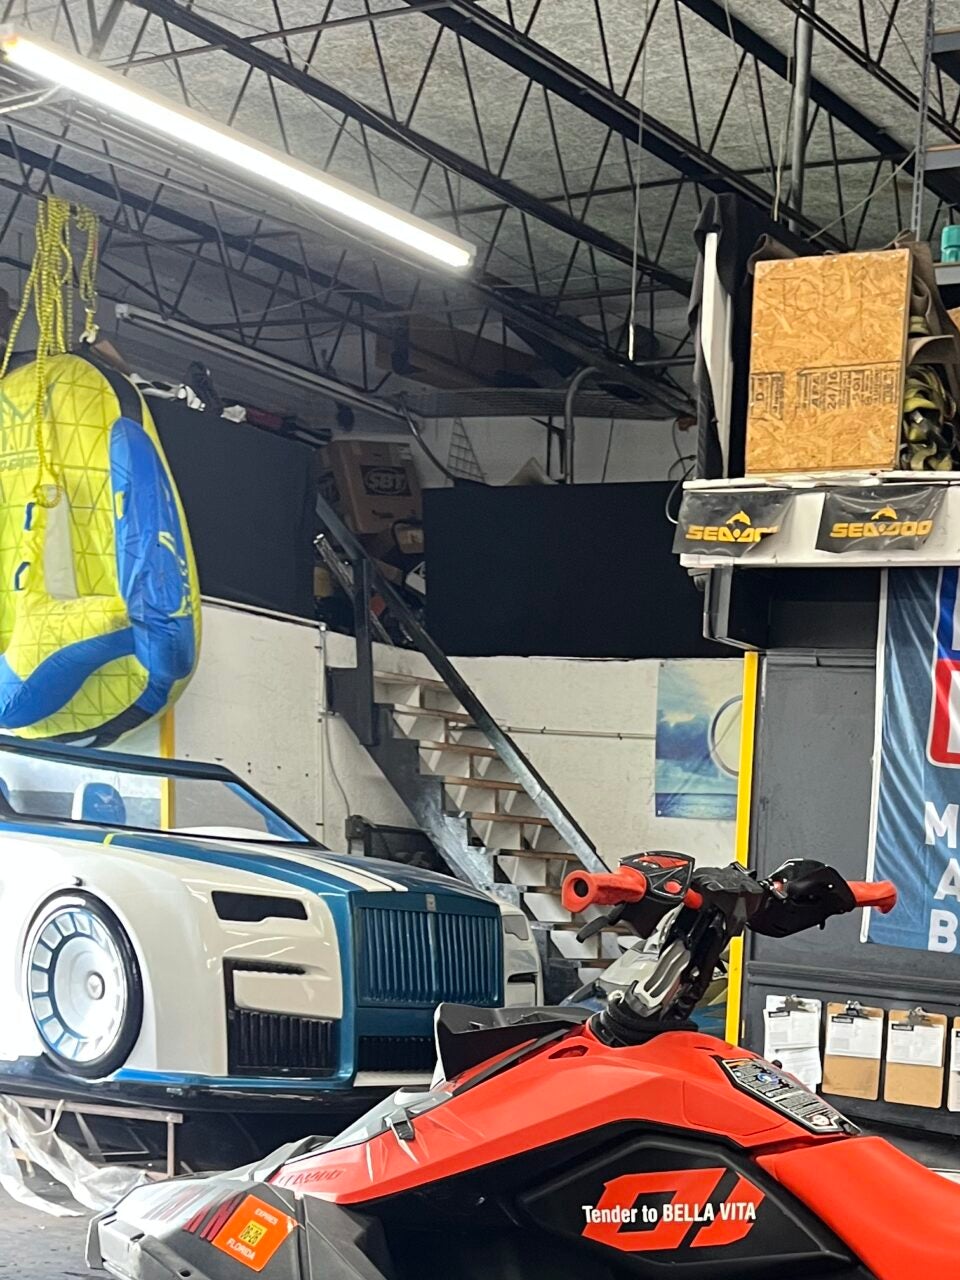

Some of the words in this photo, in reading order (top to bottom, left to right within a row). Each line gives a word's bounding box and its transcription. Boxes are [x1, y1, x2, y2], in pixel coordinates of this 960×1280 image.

[581, 1205, 638, 1224] Tender
[642, 1205, 658, 1223] to
[662, 1203, 715, 1222] BELLA
[719, 1202, 756, 1221] VITA
[226, 1237, 256, 1260] FLORIDA
